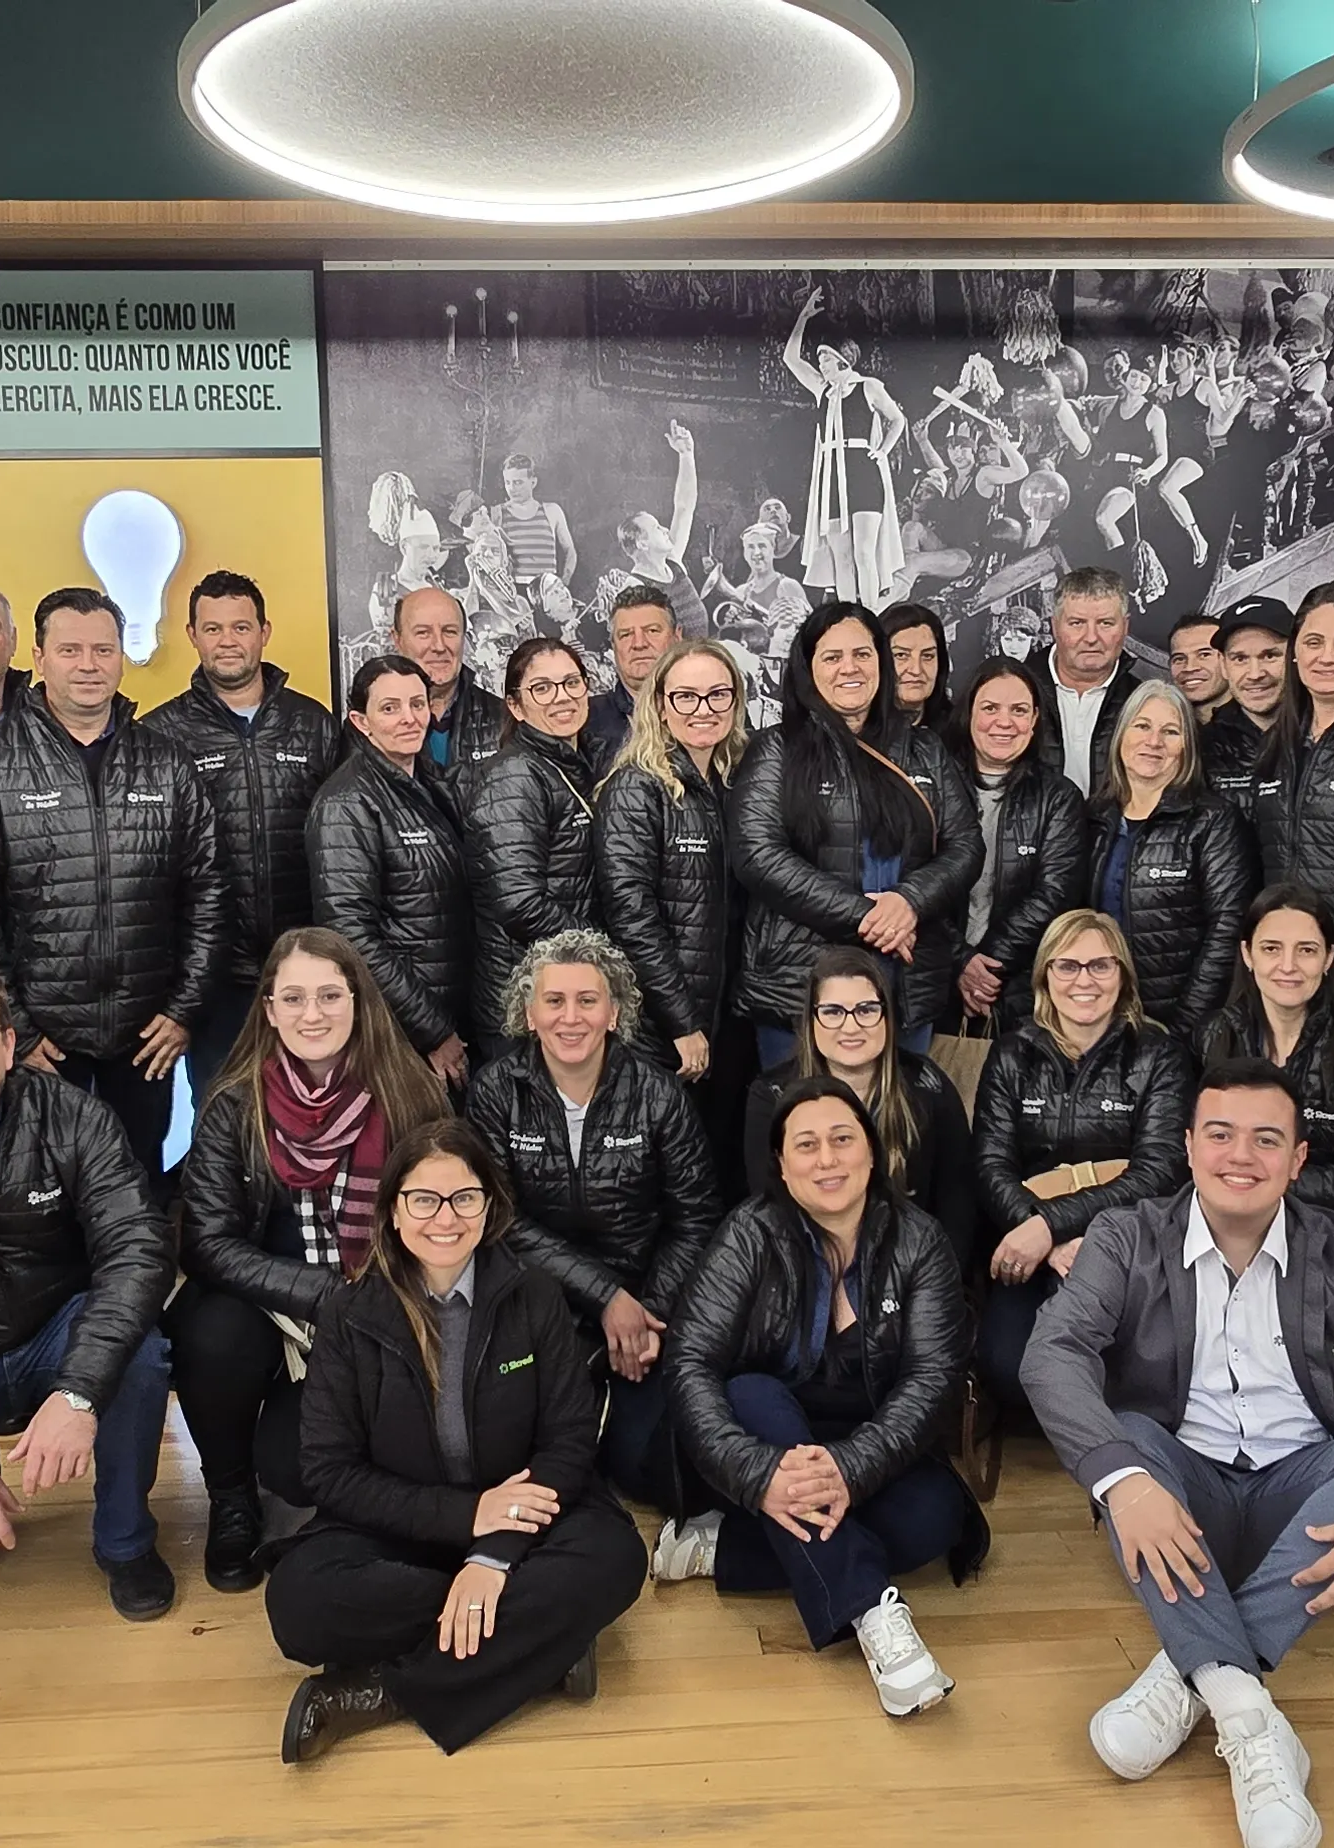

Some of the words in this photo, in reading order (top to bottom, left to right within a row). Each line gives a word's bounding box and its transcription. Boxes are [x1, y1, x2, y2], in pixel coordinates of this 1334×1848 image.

[117, 298, 129, 331] É
[134, 303, 196, 331] COMO
[202, 303, 236, 331] UM
[85, 344, 170, 372] QUANTO
[176, 344, 231, 371] MAIS
[235, 337, 292, 371] VOCÊ
[89, 384, 143, 412] MAIS
[149, 384, 189, 412] ELA
[194, 384, 281, 412] CRESCE.
[508, 1353, 534, 1371] Sicredi
